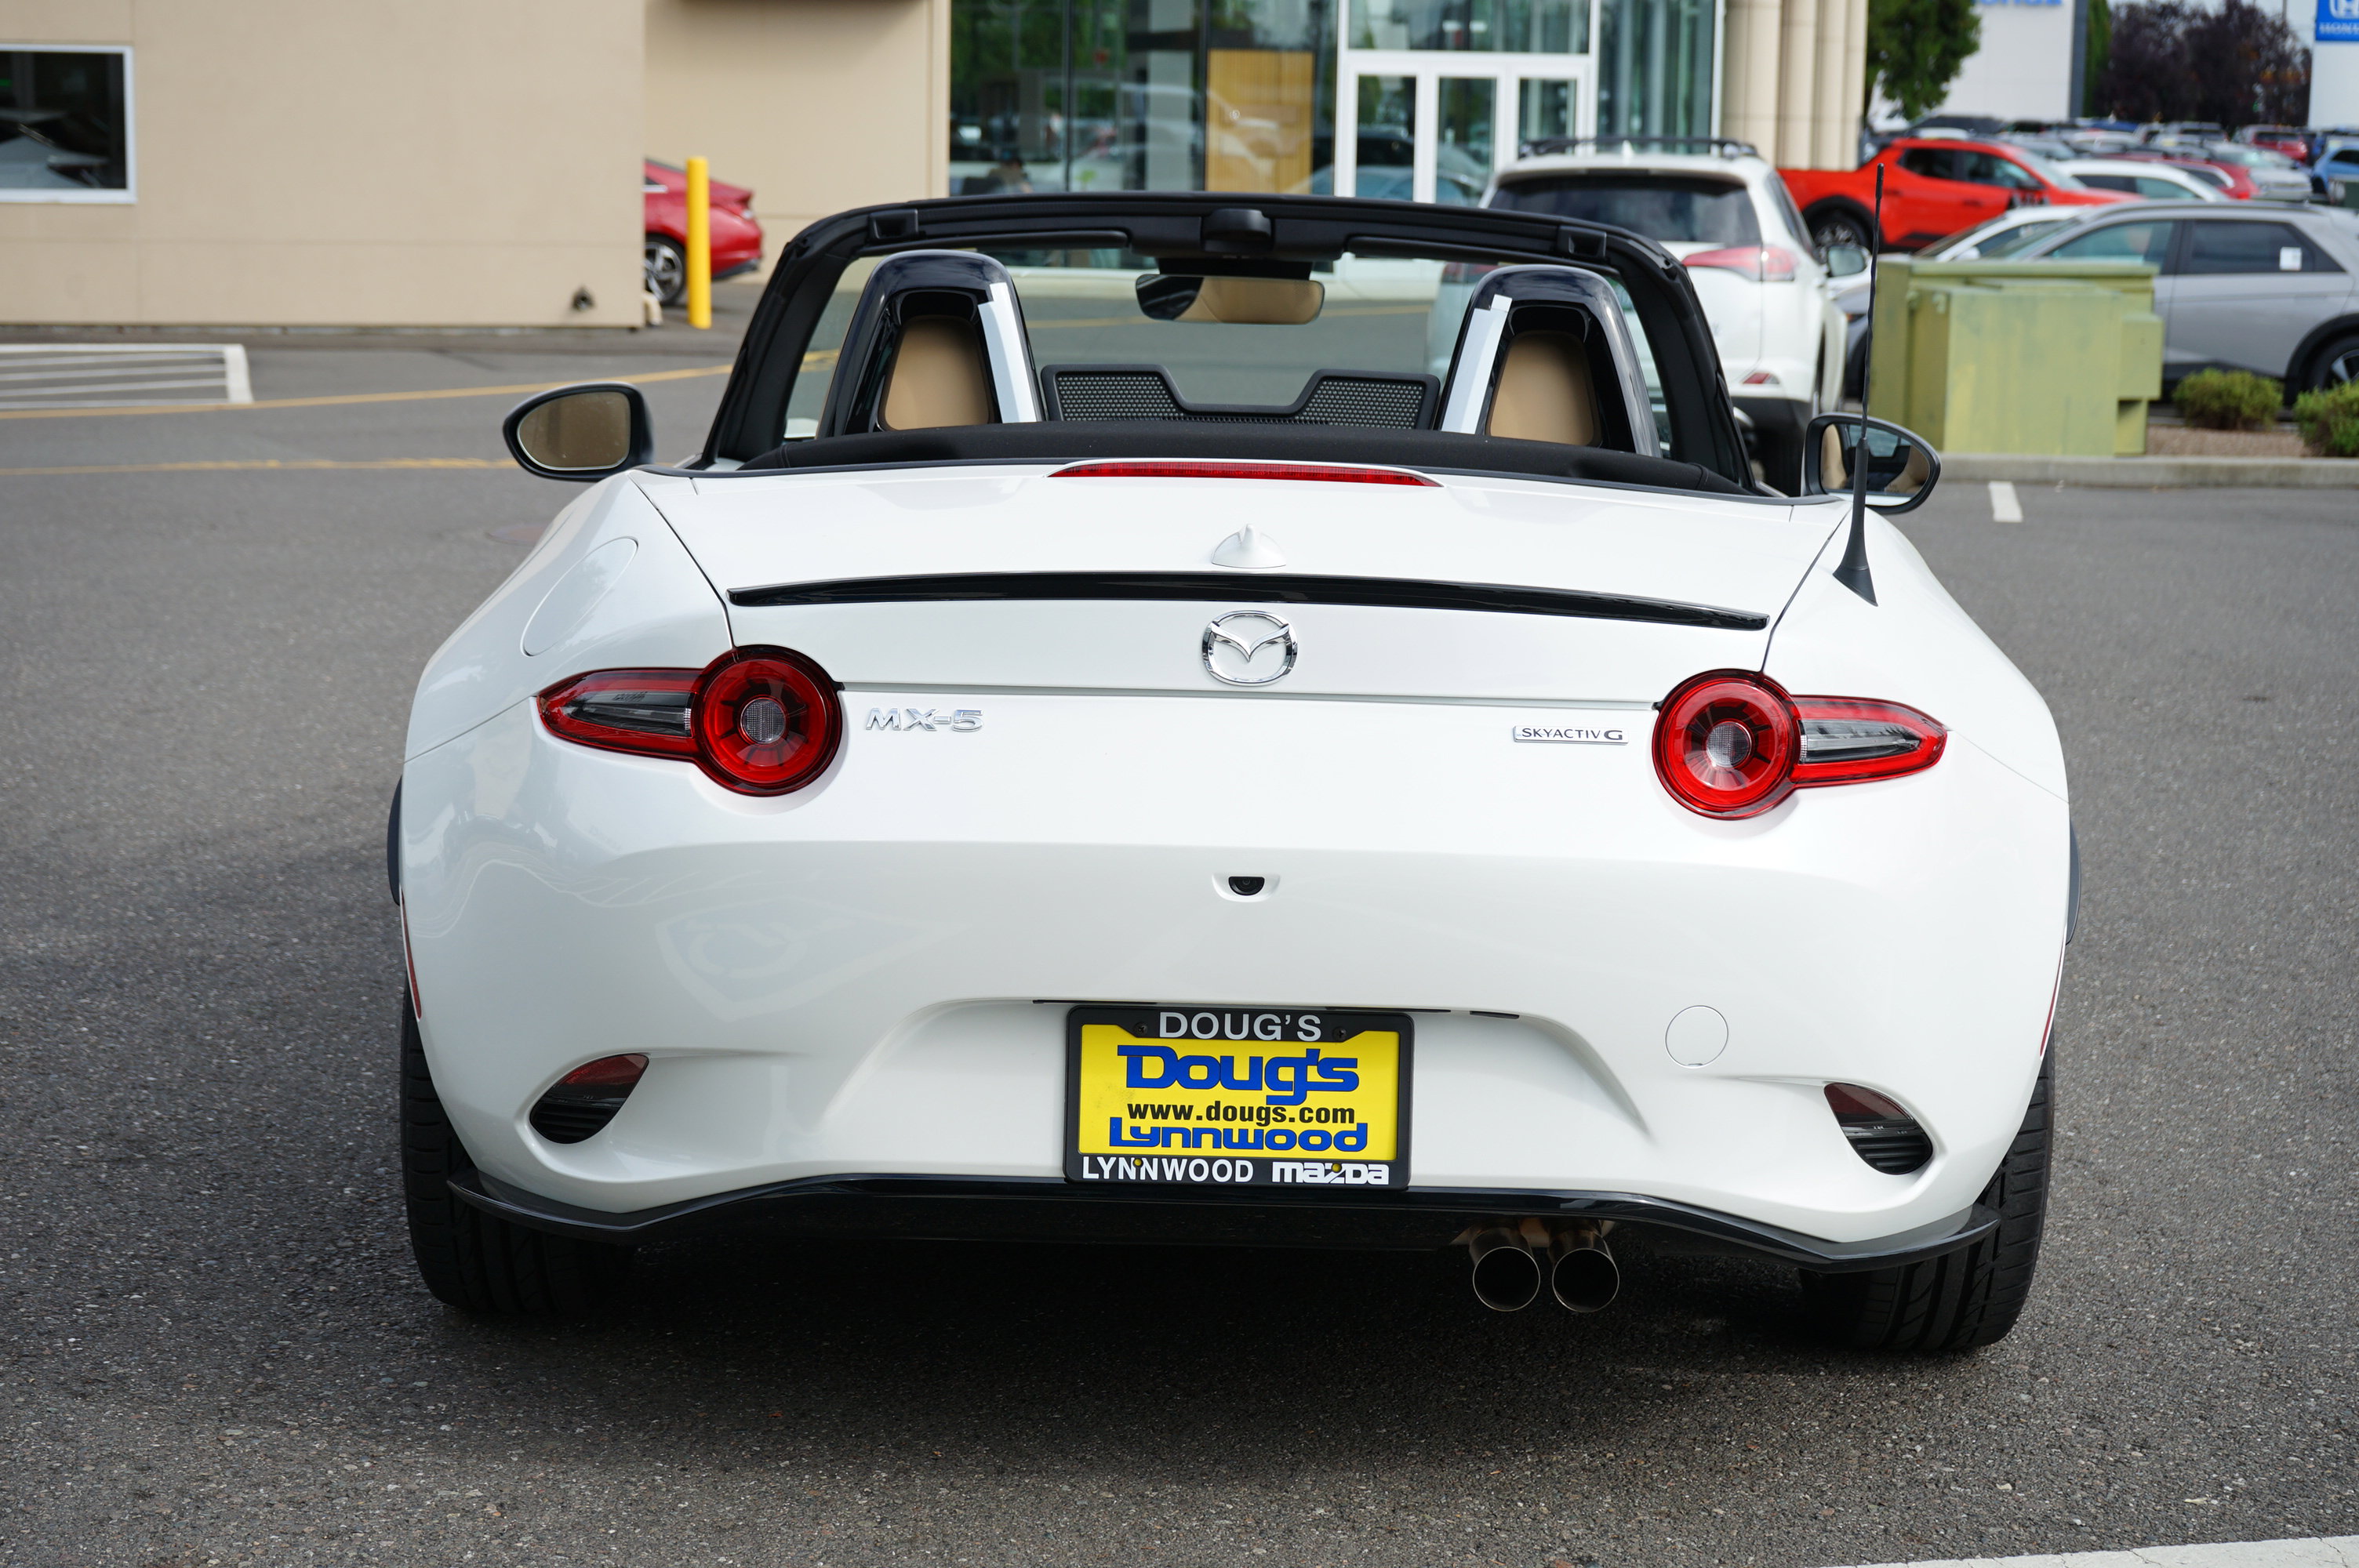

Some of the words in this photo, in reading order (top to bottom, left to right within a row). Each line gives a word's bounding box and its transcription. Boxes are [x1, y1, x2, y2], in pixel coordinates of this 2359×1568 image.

[866, 708, 983, 732] MX-5
[1159, 1011, 1322, 1042] DOUG'S
[1118, 1044, 1360, 1106] Doug's
[1127, 1100, 1356, 1127] www.dougs.com
[1110, 1117, 1369, 1152] Lynnwood
[1082, 1156, 1254, 1182] LYNNWOOD
